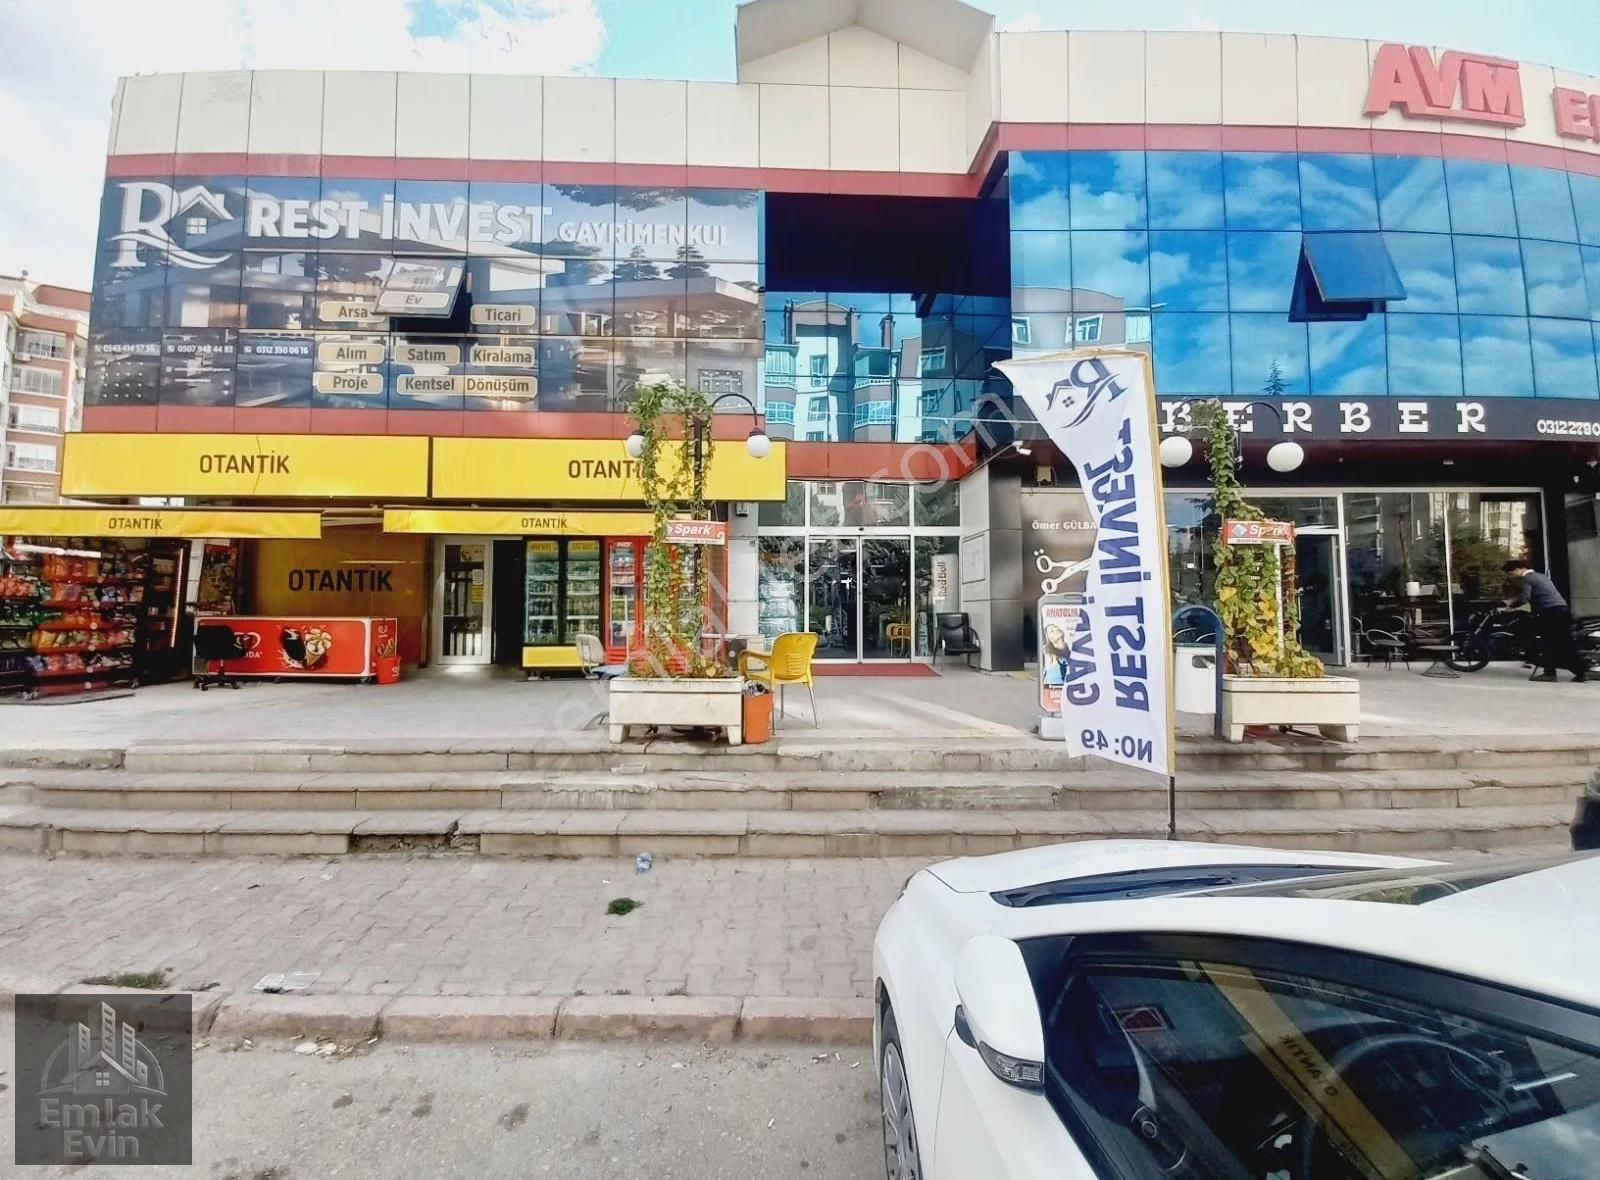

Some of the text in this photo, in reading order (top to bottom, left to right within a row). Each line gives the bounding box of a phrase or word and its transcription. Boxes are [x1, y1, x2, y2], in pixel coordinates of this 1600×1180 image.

[1364, 43, 1600, 144] AVM E
[248, 197, 368, 240] REST
[382, 193, 553, 245] İNVEST
[405, 294, 423, 305] Ev
[338, 304, 369, 319] Arsa
[484, 307, 522, 322] Ticari
[407, 348, 447, 363] Satım
[473, 349, 532, 365] Kiralama
[332, 376, 369, 392] Proje
[405, 376, 530, 395] Kentsel Dönüşüm
[1161, 401, 1487, 434] BERBER
[199, 449, 291, 475] OTANTİK
[674, 523, 711, 537] Spark
[1031, 519, 1098, 531] Ömer GÜLBA
[288, 565, 393, 594] OTANTİK
